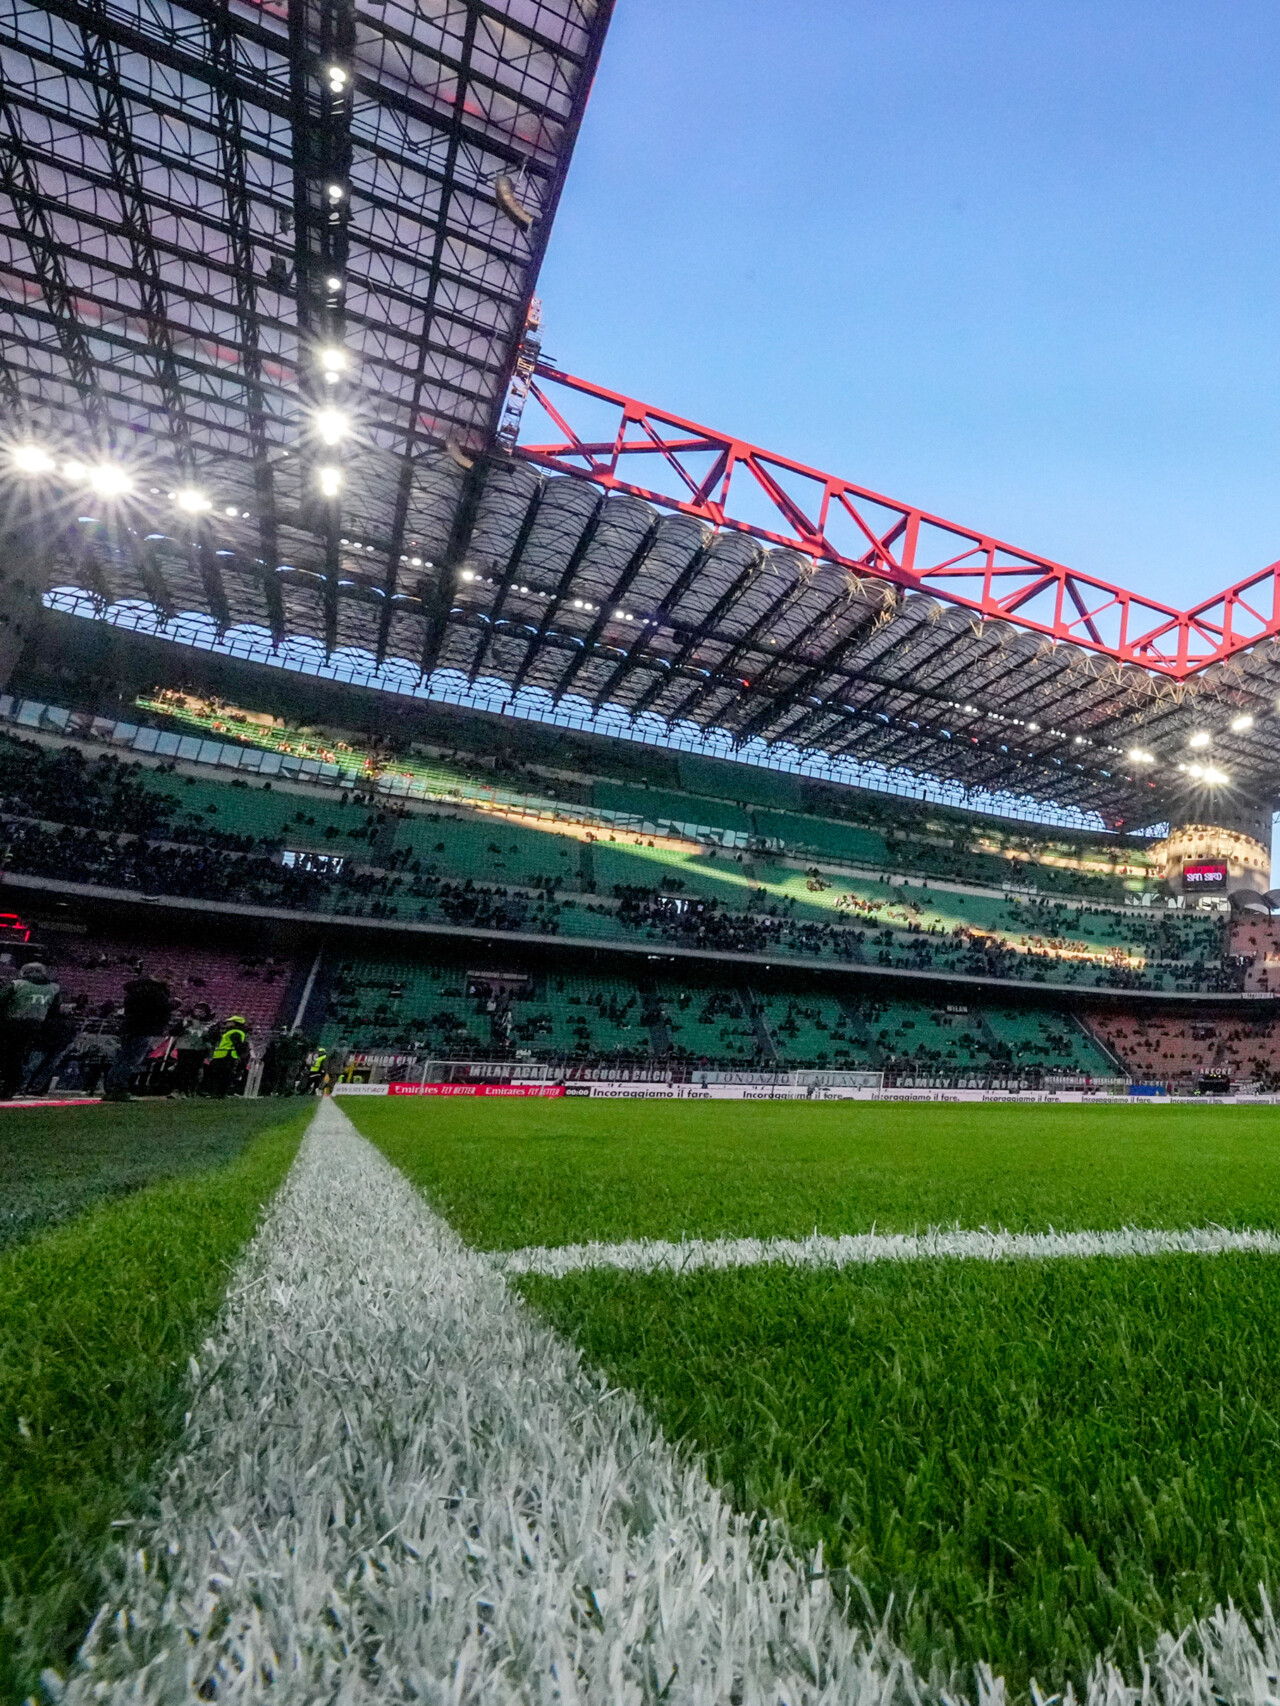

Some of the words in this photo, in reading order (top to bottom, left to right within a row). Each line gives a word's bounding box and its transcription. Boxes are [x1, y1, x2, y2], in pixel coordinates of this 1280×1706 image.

[1186, 872, 1203, 882] SAN
[1204, 872, 1223, 882] SIRO
[30, 994, 51, 1004] TV
[469, 1066, 510, 1077] MILAN
[512, 1066, 573, 1079] ACADEMY
[584, 1068, 629, 1080] SCUOLA
[631, 1070, 673, 1081] CALCIO
[896, 1078, 950, 1087] FAMILY
[957, 1079, 985, 1088] DAY
[395, 1085, 438, 1094] Emirates
[441, 1086, 452, 1095] FLY
[453, 1086, 476, 1095] BETTER
[485, 1087, 525, 1095] Emirates
[528, 1087, 539, 1096] FLY
[678, 1089, 684, 1098] il
[688, 1089, 713, 1098] fare.
